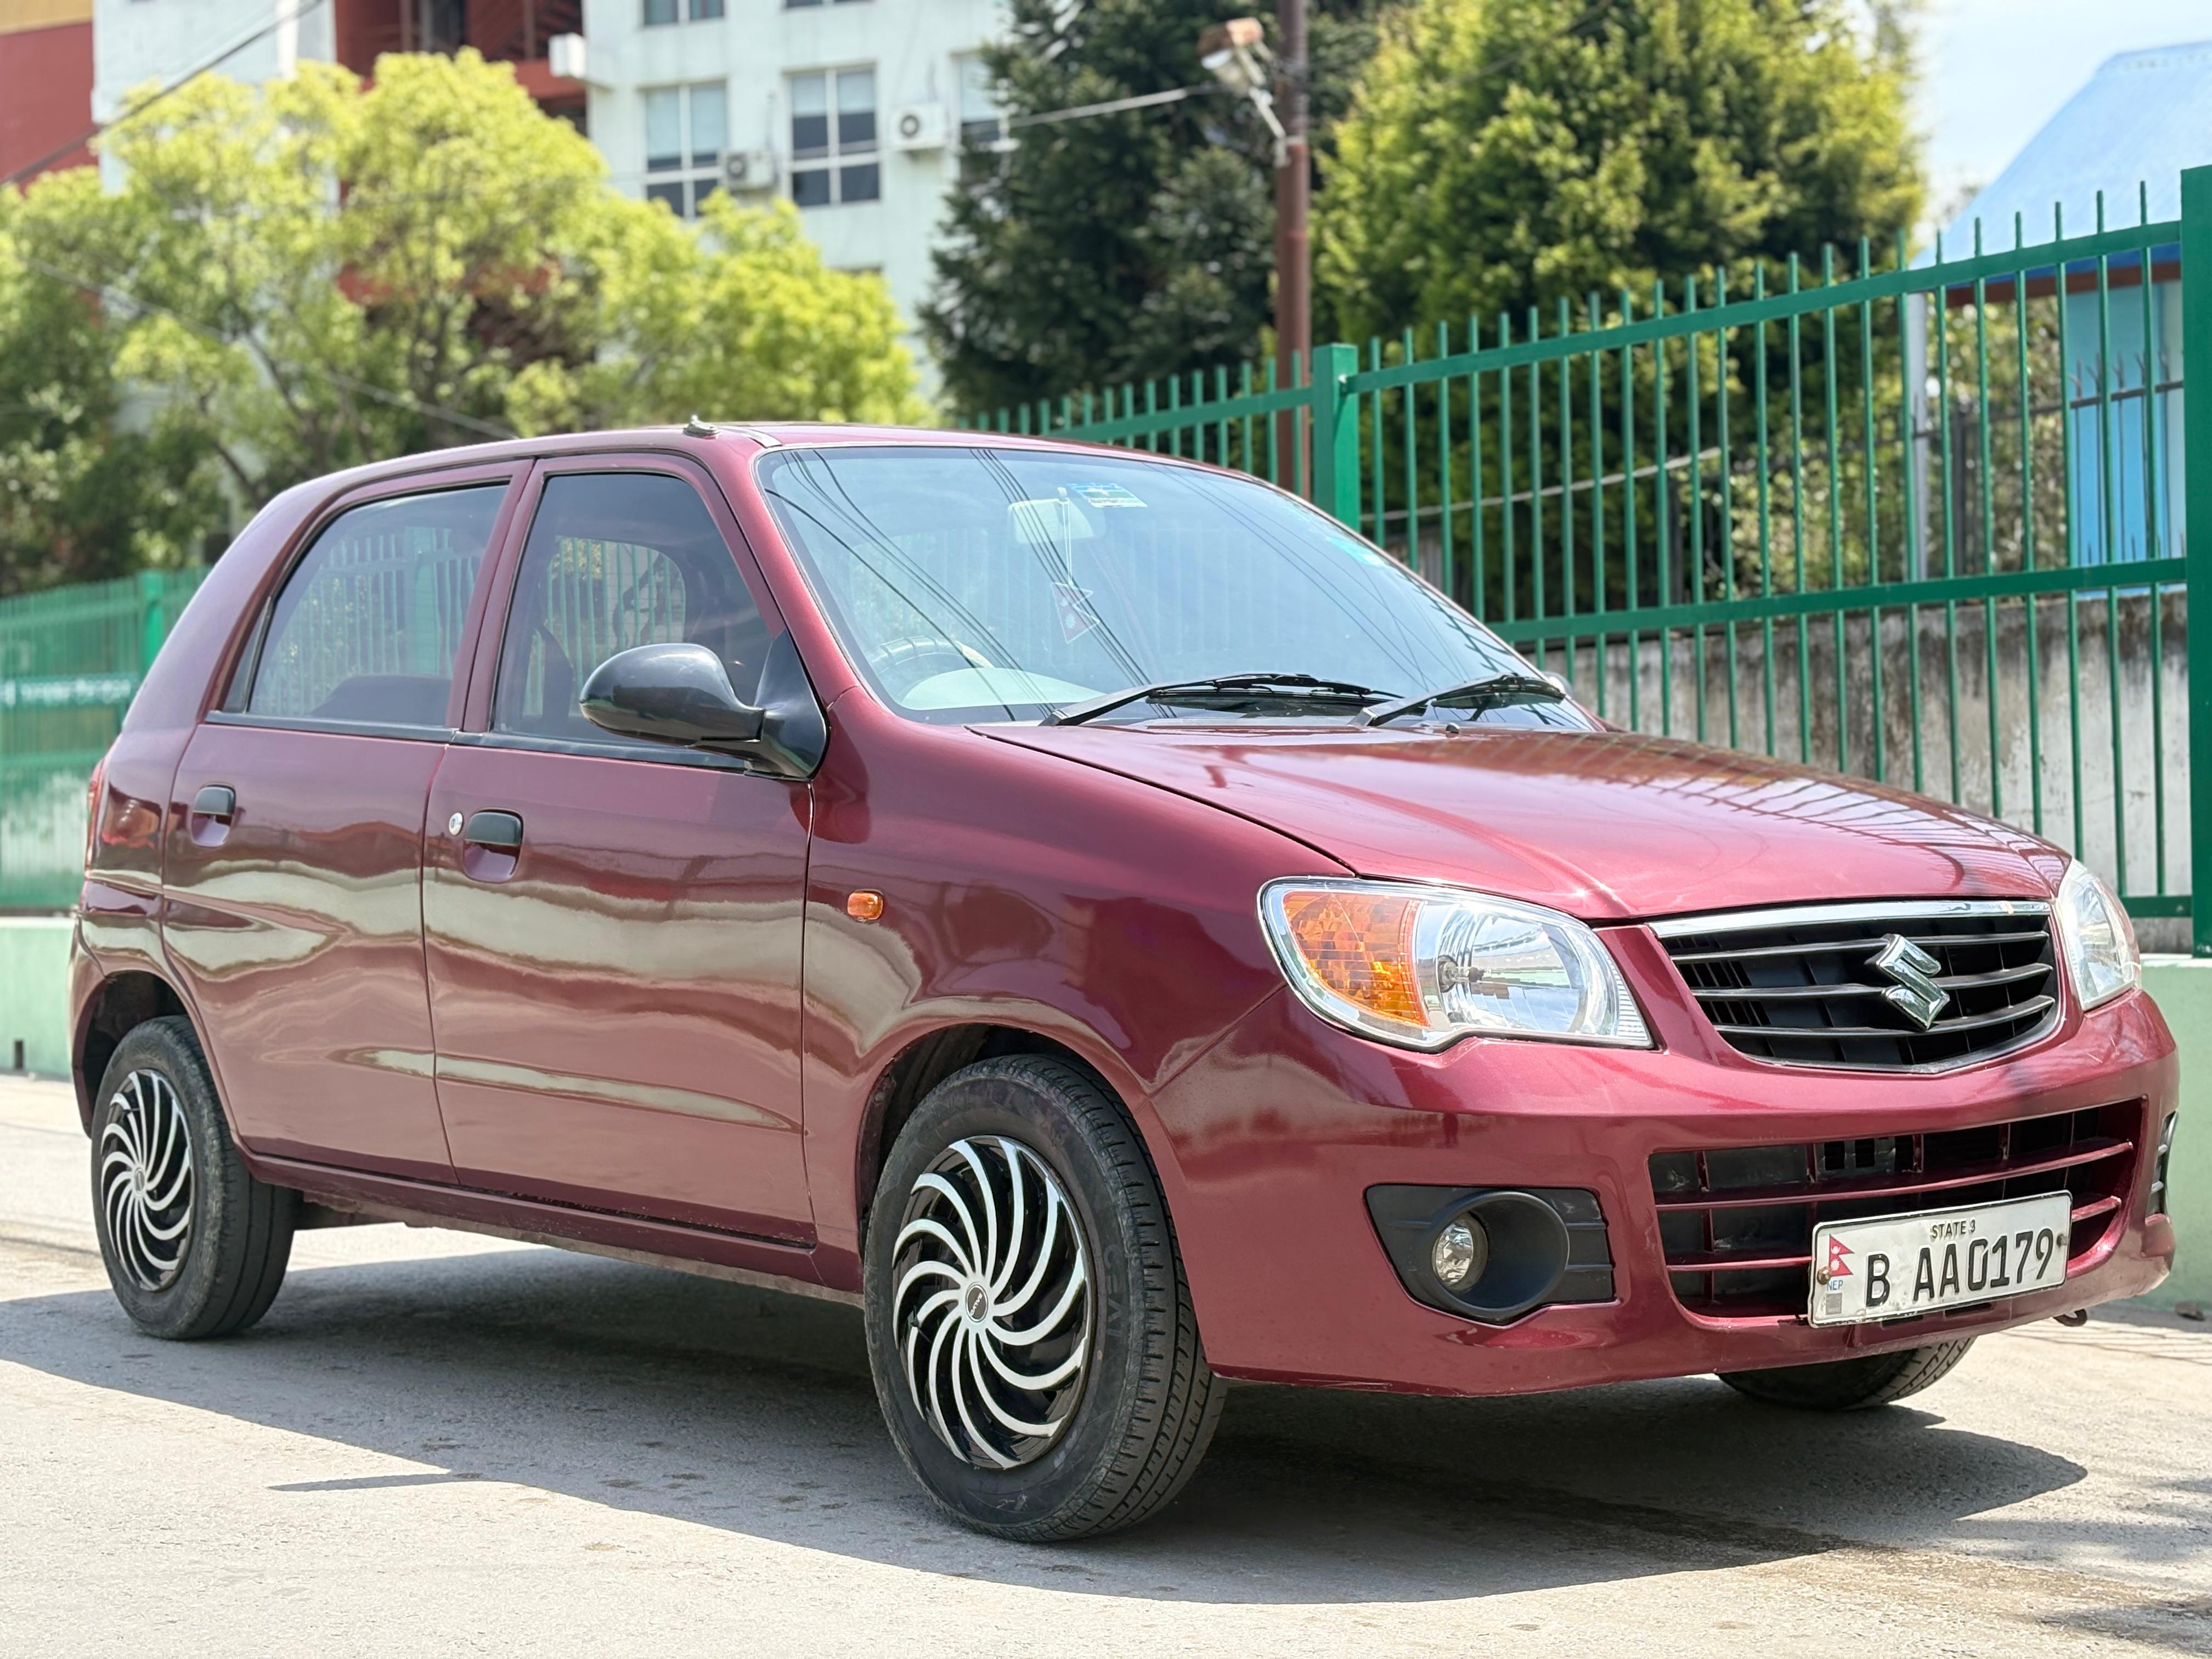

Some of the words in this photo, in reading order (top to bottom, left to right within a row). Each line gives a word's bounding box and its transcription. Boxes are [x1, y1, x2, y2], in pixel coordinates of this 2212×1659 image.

[1931, 1220, 1967, 1239] STATE
[1970, 1218, 1976, 1233] 3
[1866, 1253, 1891, 1307] B
[1913, 1228, 2054, 1302] AA0179
[1826, 1279, 1844, 1292] NEP
